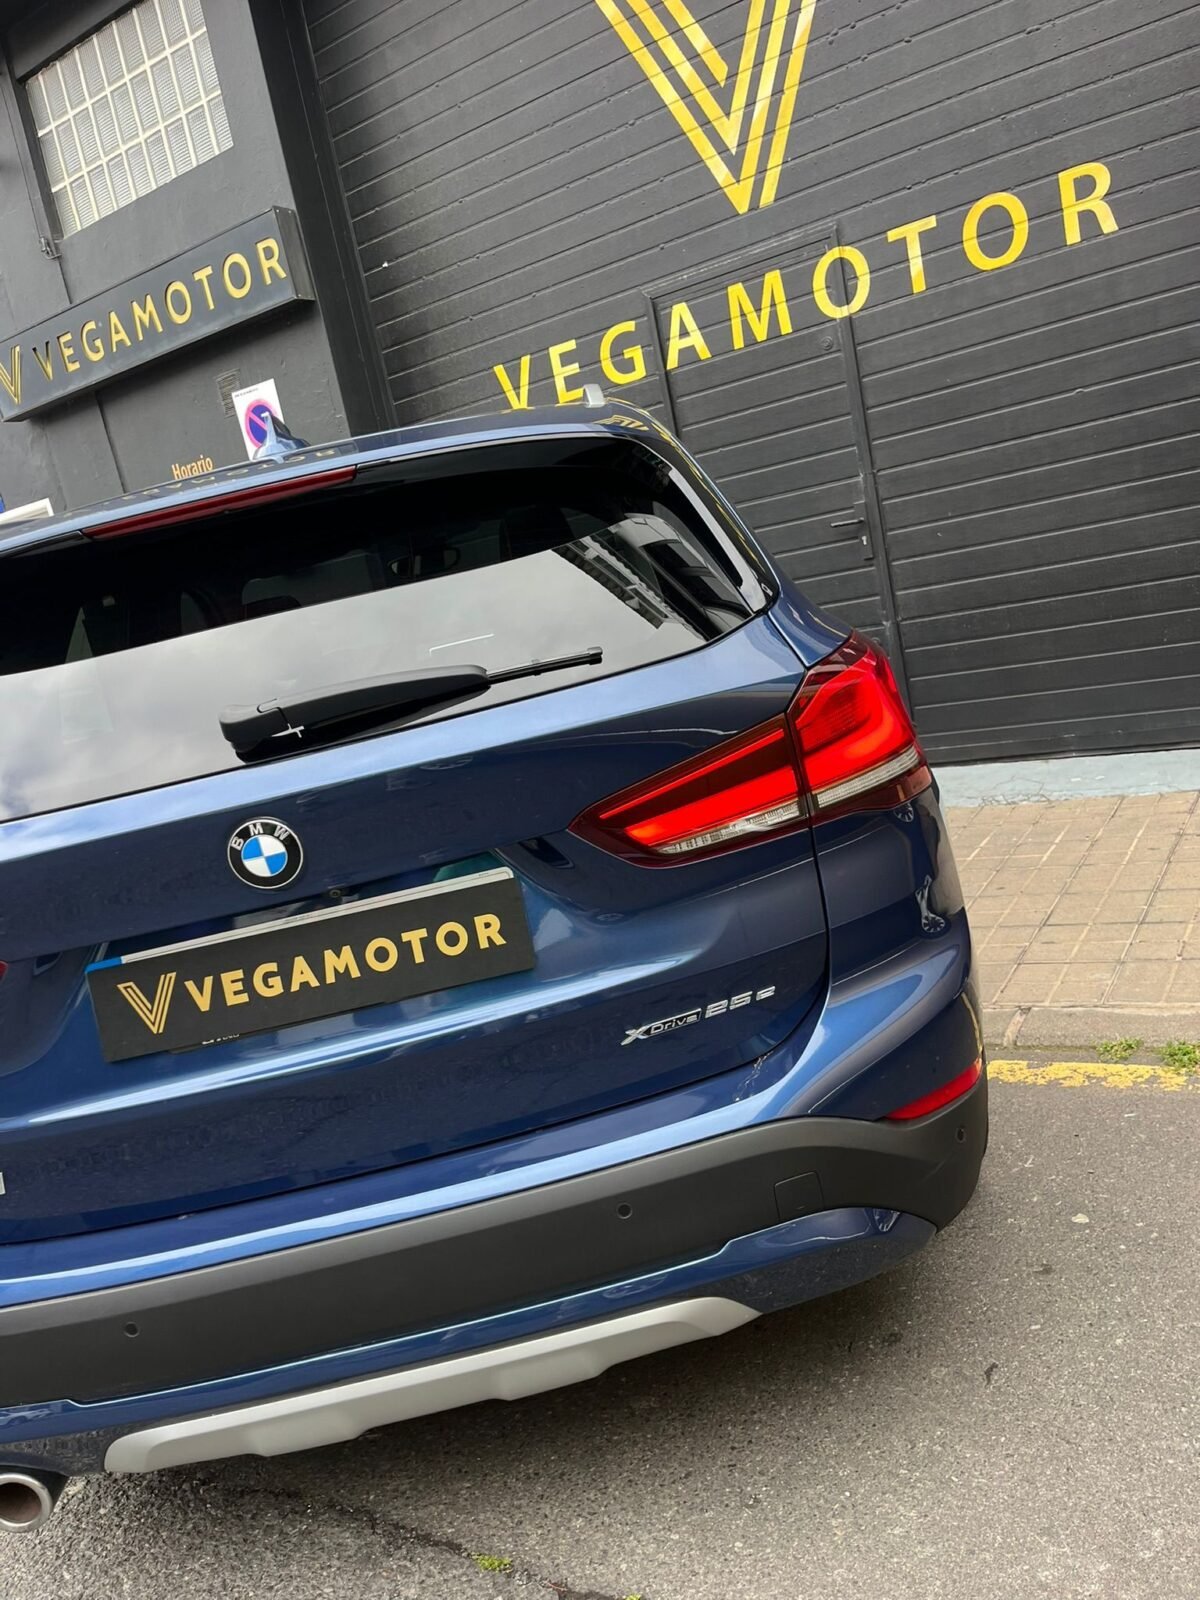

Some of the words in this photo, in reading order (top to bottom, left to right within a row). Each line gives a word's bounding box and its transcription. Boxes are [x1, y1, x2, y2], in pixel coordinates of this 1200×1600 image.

[32, 237, 287, 381] VEGAMOTOR
[493, 161, 1119, 410] VEGAMOTOR
[171, 454, 214, 480] Horario
[231, 822, 290, 851] BMW
[184, 913, 507, 1012] VEGAMOTOR
